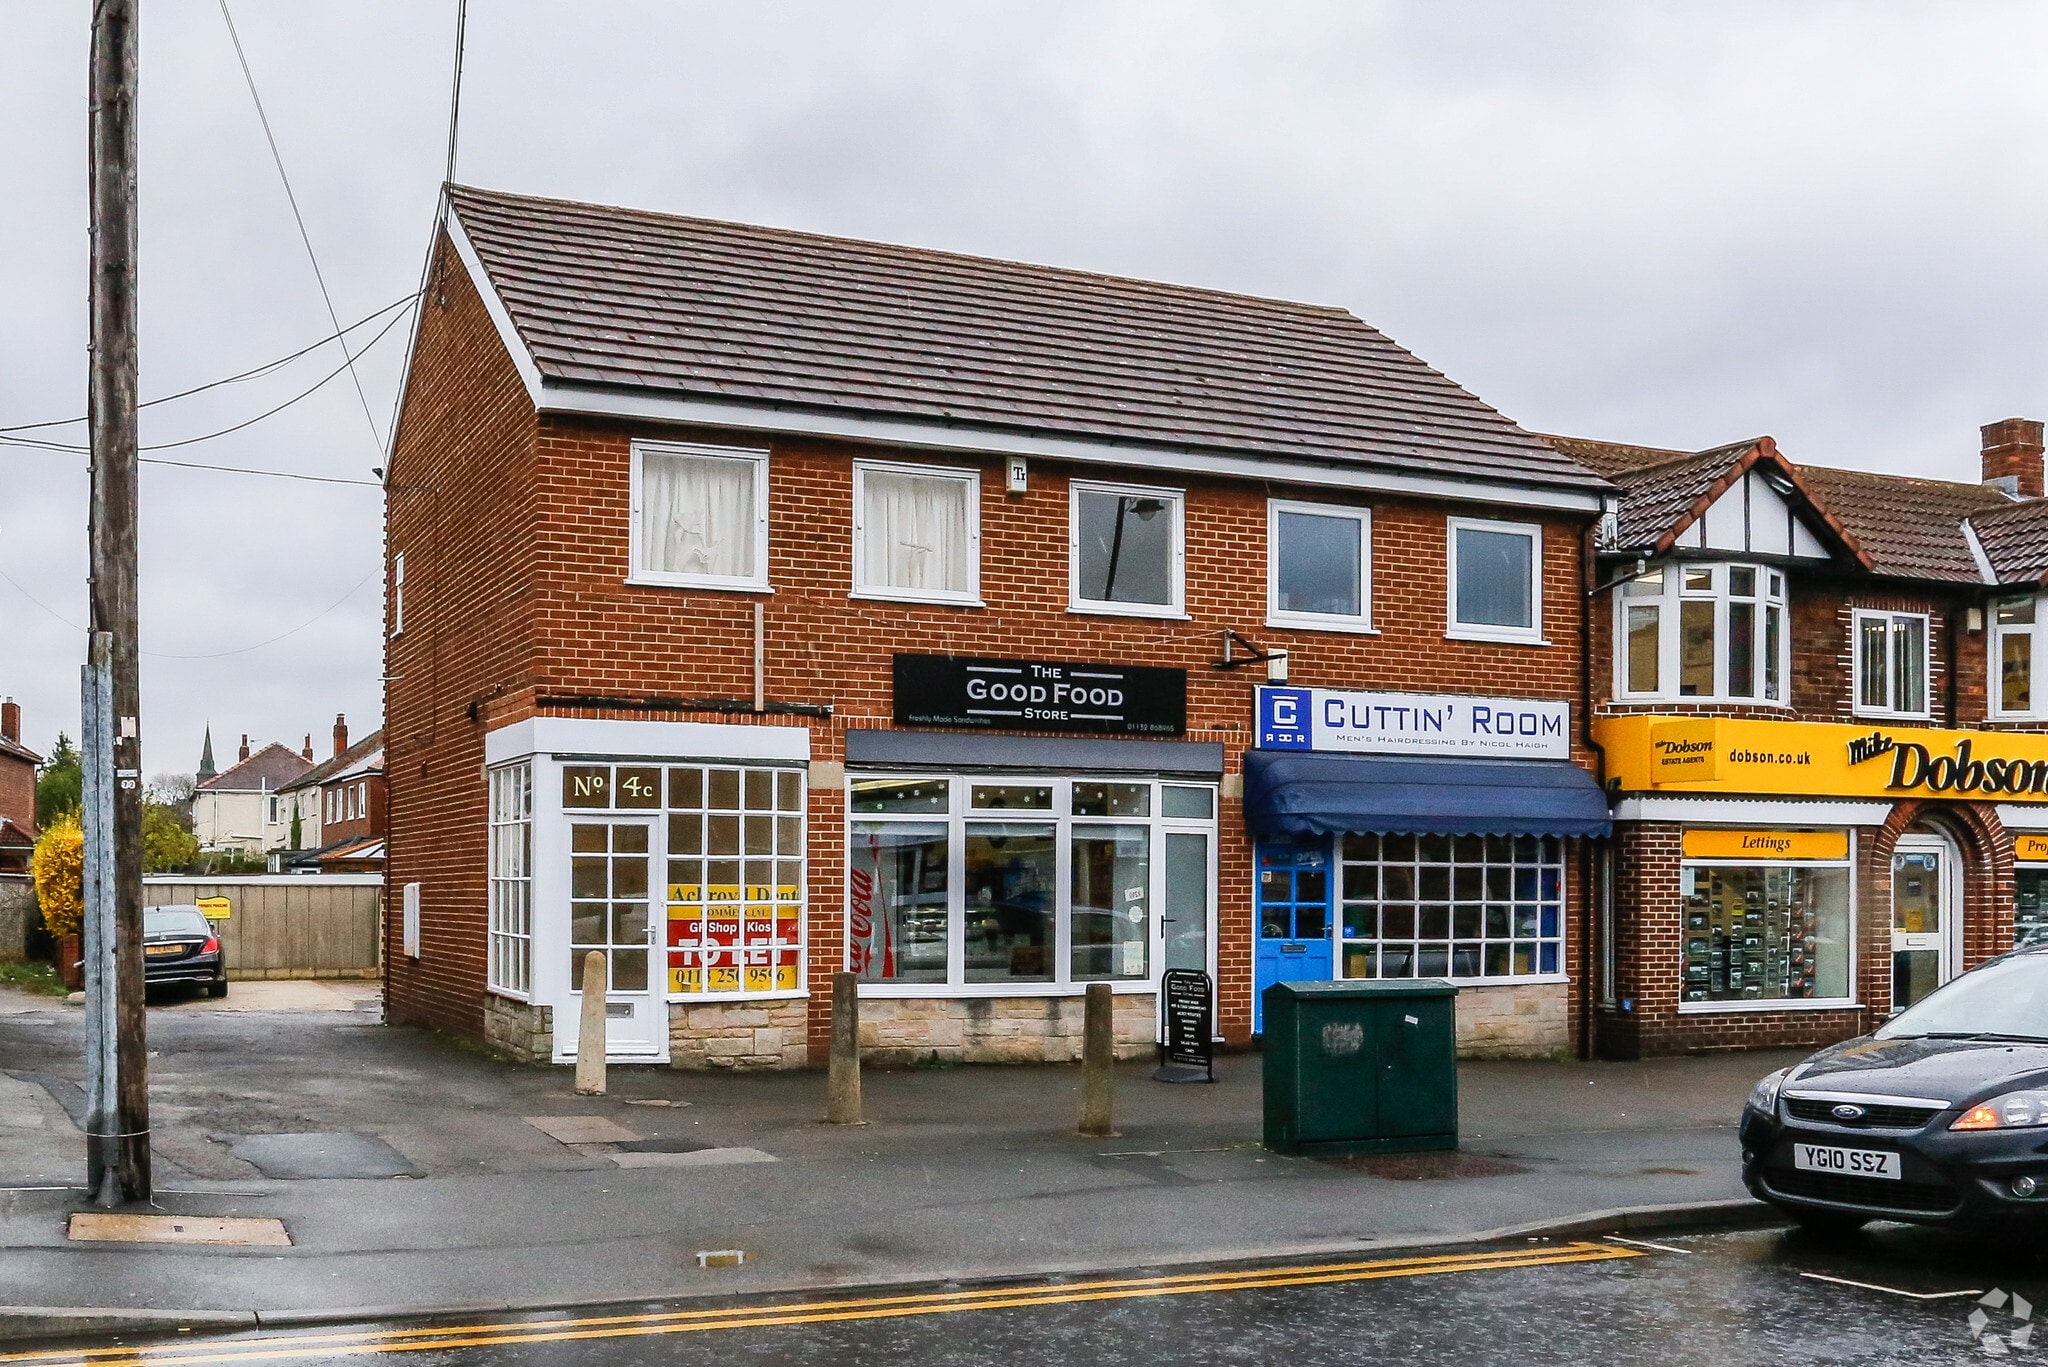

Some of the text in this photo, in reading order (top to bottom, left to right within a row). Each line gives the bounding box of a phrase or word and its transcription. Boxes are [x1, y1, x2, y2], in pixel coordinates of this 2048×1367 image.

[1031, 664, 1062, 679] THE
[966, 678, 1124, 706] GOOD FOOD
[1024, 707, 1069, 721] STORE
[1325, 699, 1561, 737] CUTTIN' ROOM
[1336, 734, 1372, 743] MEN'S
[1377, 736, 1456, 746] HAIRDRESSING
[1461, 739, 1475, 747] BY
[1479, 740, 1512, 748] NICOL
[1664, 739, 1713, 754] Dobson
[1846, 731, 1893, 766] Mike
[1729, 748, 1811, 765] dobson.co.uk
[1742, 834, 1791, 851] Lettings
[756, 887, 798, 901] Dnt
[700, 907, 768, 917] OMMECIAL
[708, 922, 738, 935] Shop
[747, 922, 778, 933] Kios
[678, 937, 788, 966] TO LET
[1805, 1147, 1888, 1174] YG10 SSZ
